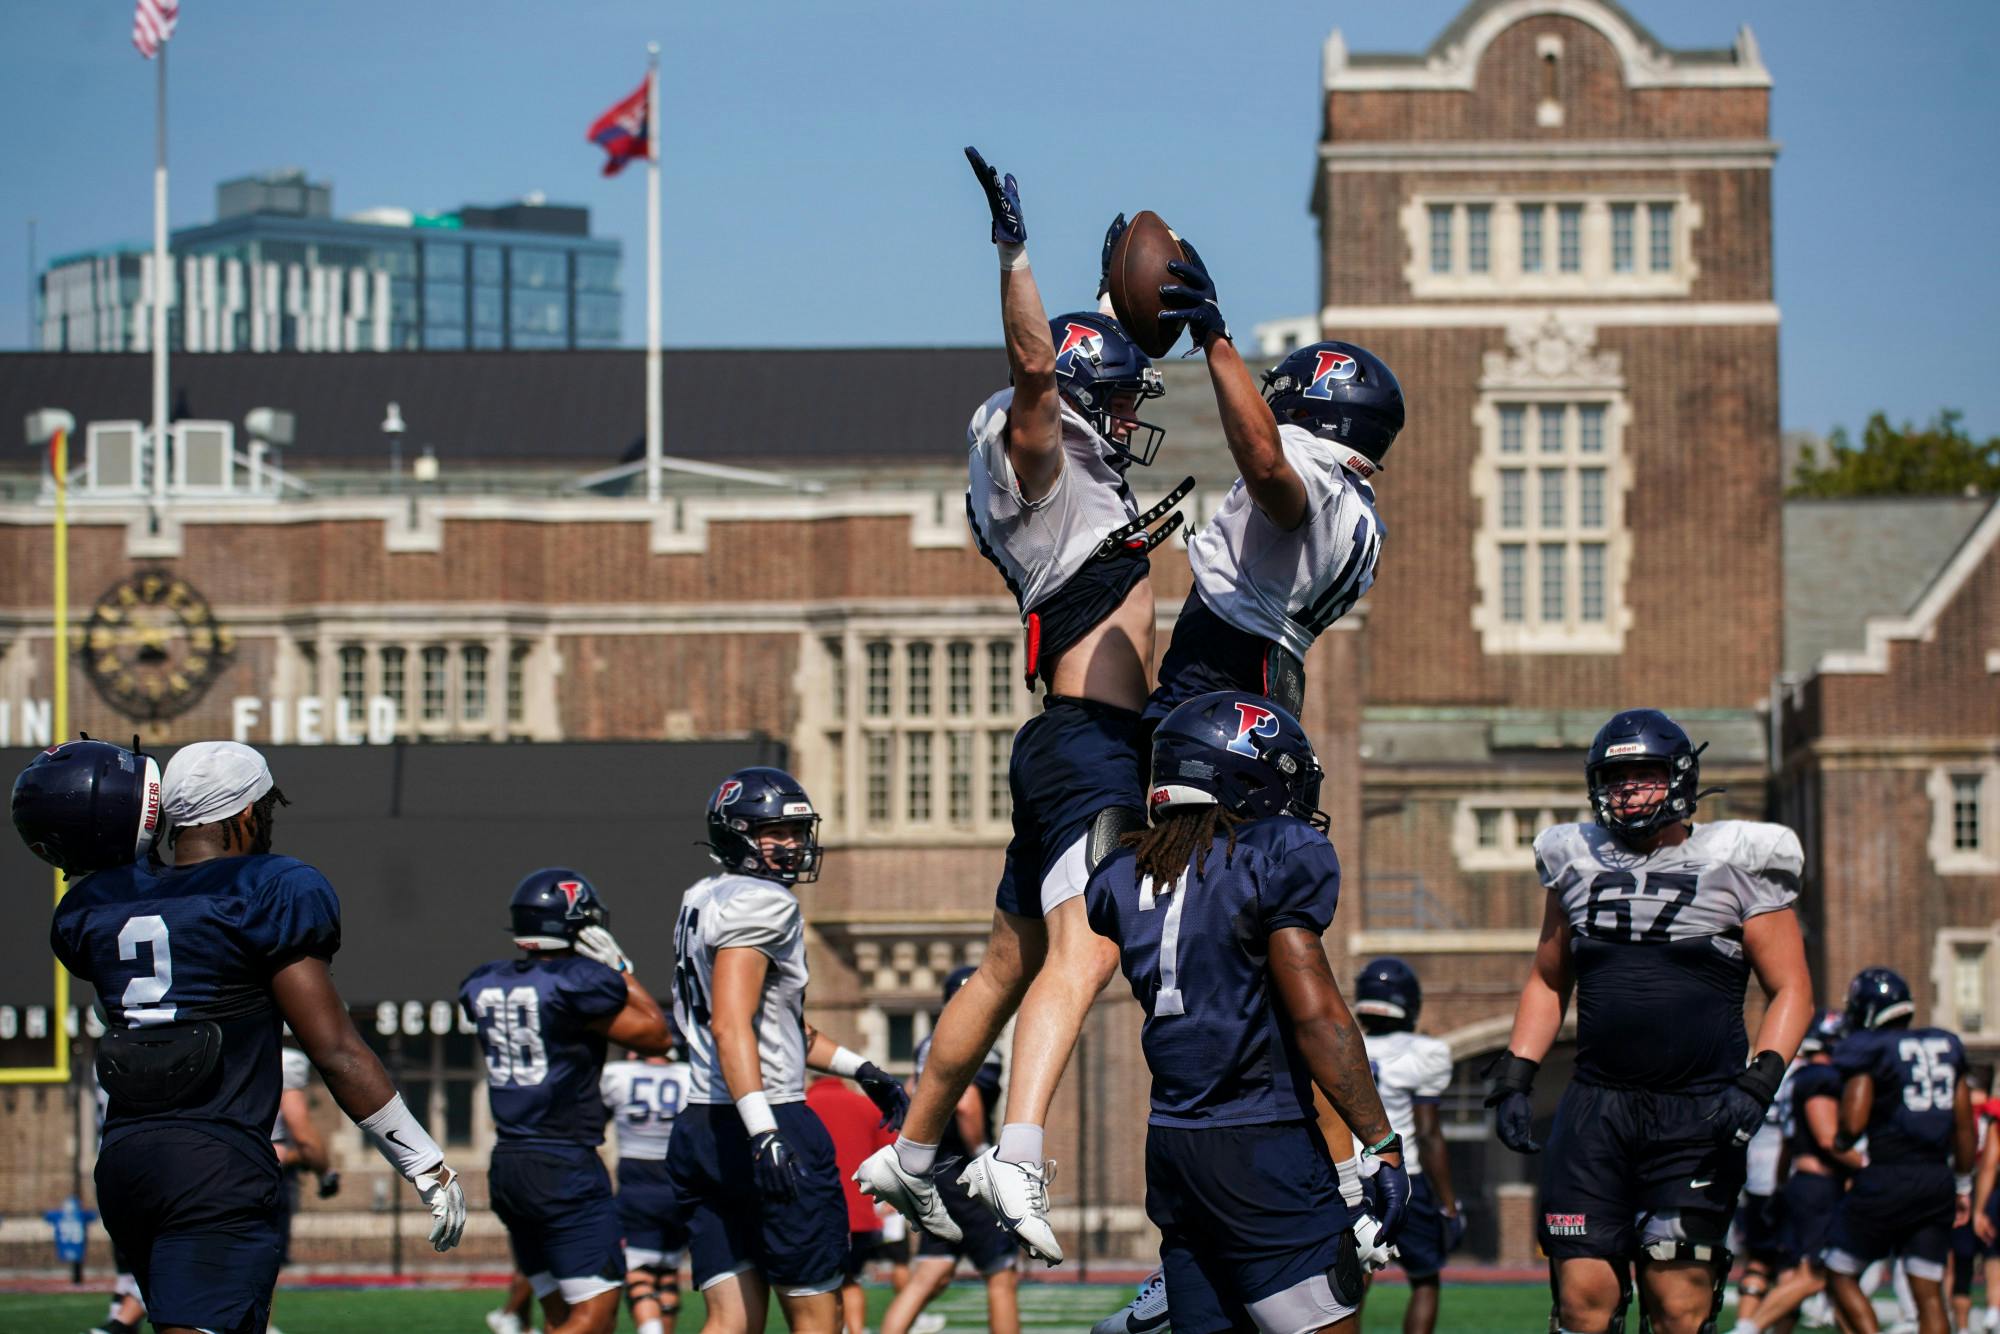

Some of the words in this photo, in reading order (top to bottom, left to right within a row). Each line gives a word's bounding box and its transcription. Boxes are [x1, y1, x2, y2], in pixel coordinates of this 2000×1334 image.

[1303, 350, 1357, 400] P
[232, 696, 397, 745] FIELD
[1226, 702, 1280, 760] P
[1608, 745, 1638, 755] Riddell
[144, 782, 160, 831] QUAKERS
[1586, 871, 1698, 943] 67
[1139, 864, 1191, 1017] 7
[118, 914, 178, 1030] 2
[476, 986, 548, 1087] 38
[1899, 1037, 1955, 1112] 35
[628, 1077, 681, 1125] 59
[1545, 1213, 1586, 1227] PENN
[1548, 1225, 1587, 1236] OOTBALL
